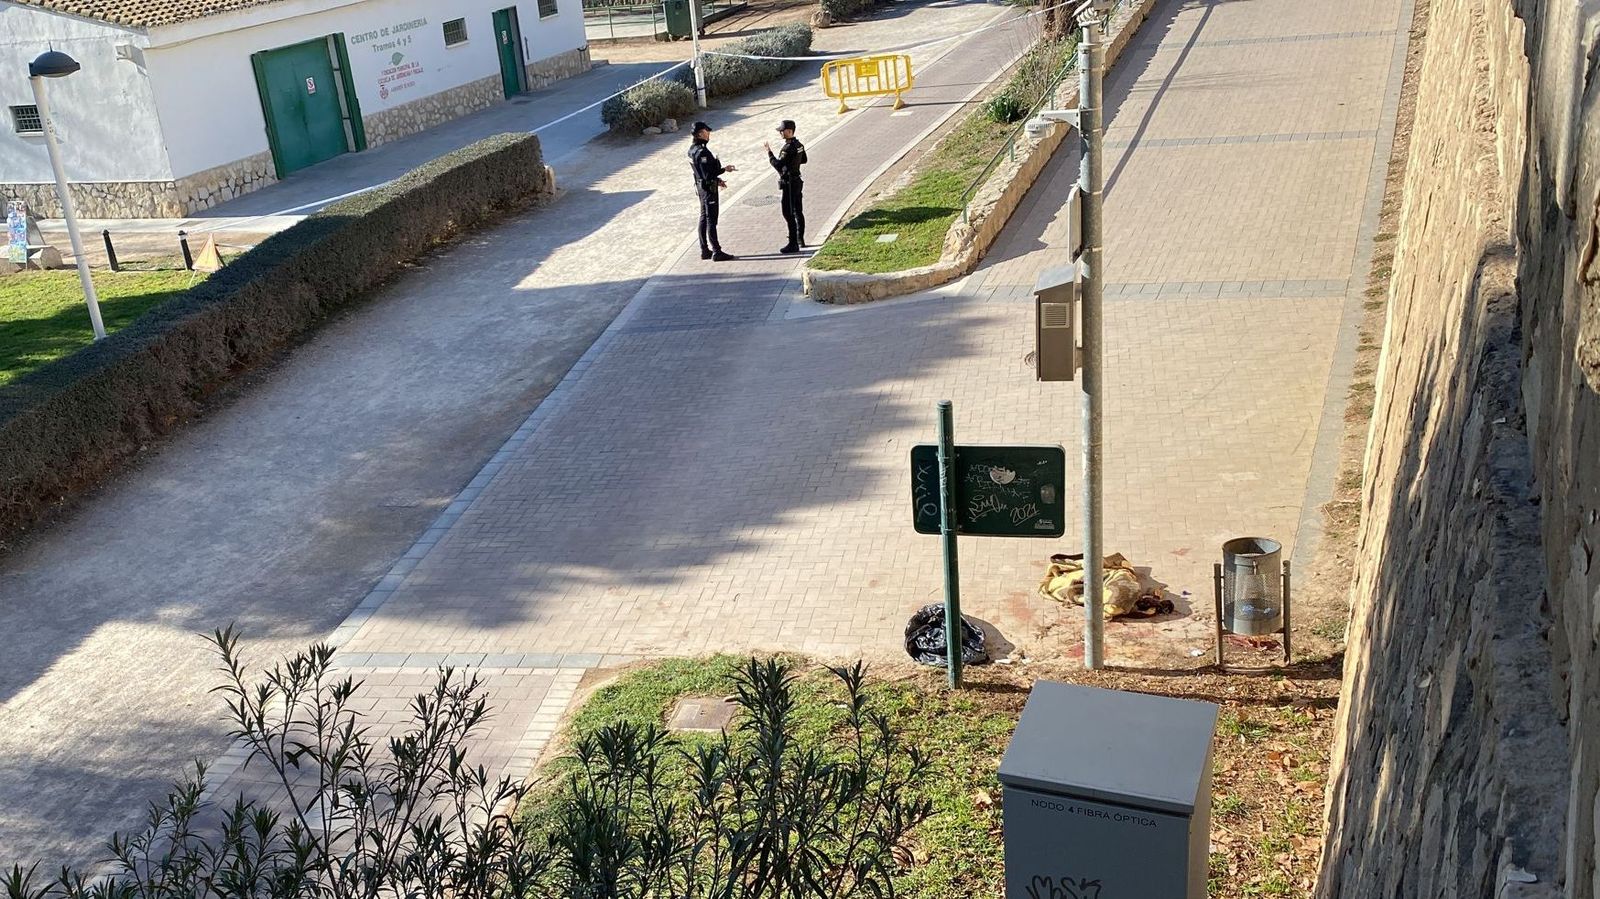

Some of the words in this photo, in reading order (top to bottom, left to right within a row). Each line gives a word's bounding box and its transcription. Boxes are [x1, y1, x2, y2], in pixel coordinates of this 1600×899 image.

[351, 30, 378, 44] CENTRO
[380, 27, 389, 37] DE
[373, 41, 395, 52] Tramos
[1010, 503, 1038, 523] 2021
[1031, 799, 1065, 812] NODO
[1067, 806, 1075, 814] 4
[1076, 807, 1112, 820] FIBRA
